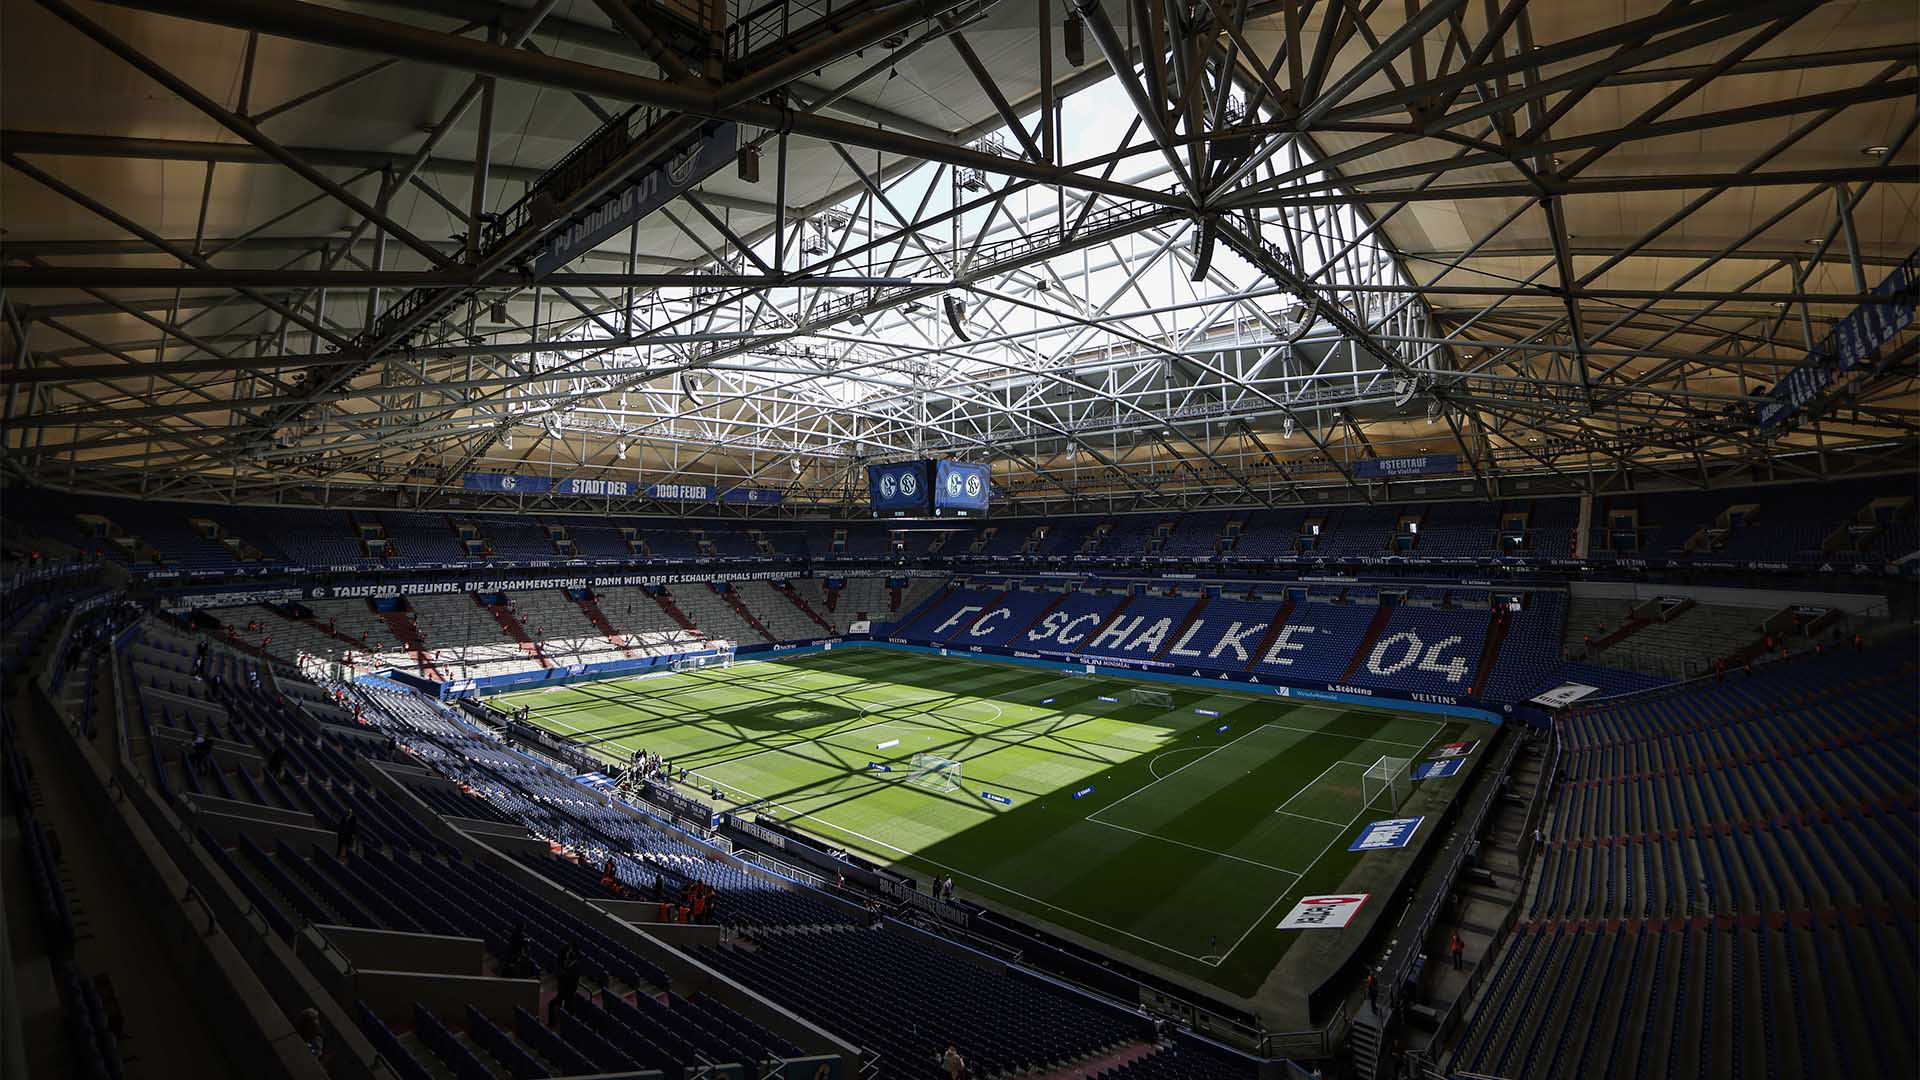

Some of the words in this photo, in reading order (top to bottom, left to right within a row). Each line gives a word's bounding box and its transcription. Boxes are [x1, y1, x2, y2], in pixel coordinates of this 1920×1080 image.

[1380, 458, 1428, 470] #STEHTAUF
[572, 478, 606, 495] STADT
[608, 481, 627, 496] DER
[656, 484, 678, 498] 1000
[680, 485, 707, 500] FEUER
[332, 584, 396, 597] TAUSEND
[400, 582, 461, 595] FREUNDE,
[466, 581, 483, 592] DIE
[486, 578, 586, 592] ZUSAMMENSTEHEN
[595, 577, 621, 587] DANN
[623, 576, 648, 585] WIRD
[650, 575, 667, 584] DER
[669, 574, 679, 583] FC
[681, 573, 716, 583] SCHALKE
[717, 572, 750, 582] NIEMALS
[752, 570, 801, 580] UNTERGEHEN!
[934, 605, 1010, 638] FC
[1027, 611, 1315, 666] SCHALKE
[1366, 630, 1469, 683] 04
[969, 645, 983, 653] HRS
[1080, 657, 1102, 666] SUN
[1335, 684, 1373, 696] Stölting
[1411, 692, 1457, 705] VELTINS
